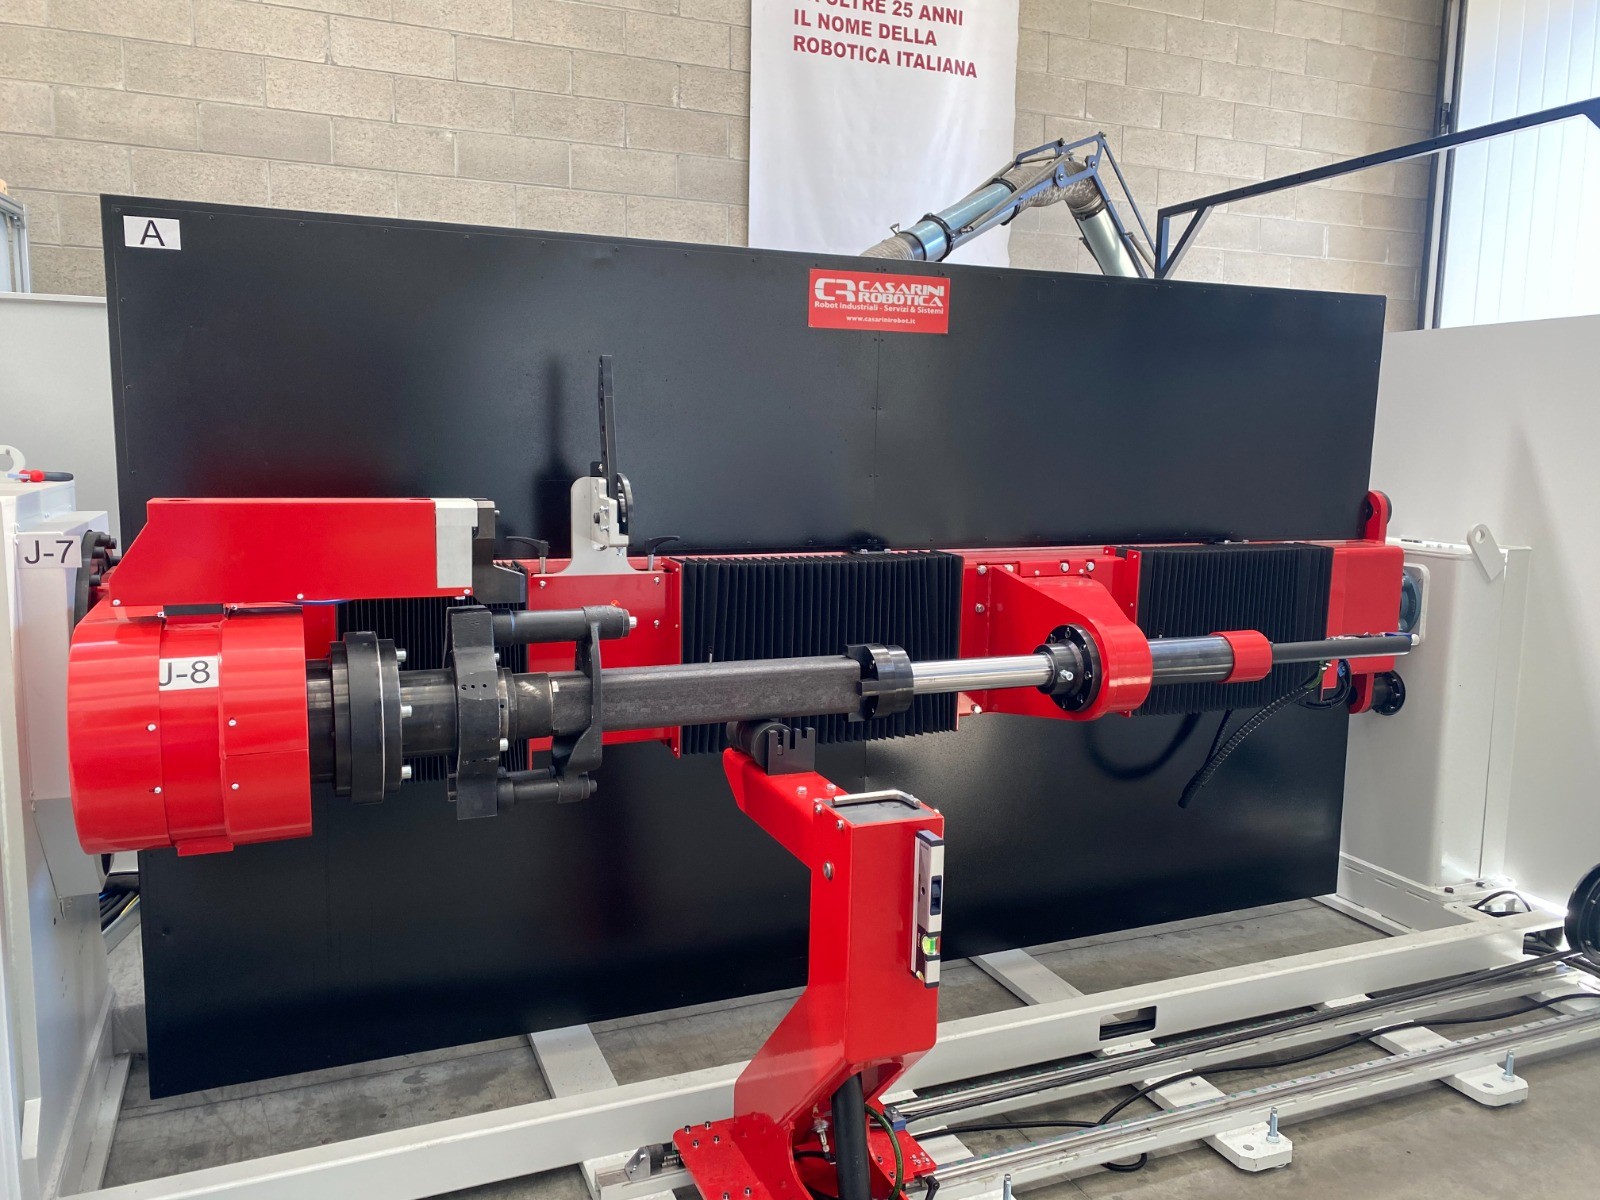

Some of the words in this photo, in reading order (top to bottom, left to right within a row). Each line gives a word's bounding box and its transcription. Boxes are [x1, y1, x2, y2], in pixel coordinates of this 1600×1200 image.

[892, 0, 913, 18] 25
[918, 5, 964, 26] ANNI
[793, 9, 811, 26] IL
[817, 13, 872, 37] NOME
[878, 23, 937, 46] DELLA
[793, 35, 890, 65] ROBOTICA
[897, 50, 978, 78] ITALIANA
[140, 219, 165, 246] A
[858, 280, 945, 296] CASARINI
[858, 291, 943, 307] ROBOTICA
[814, 301, 838, 309] Robot
[840, 302, 878, 311] Industriali
[884, 305, 909, 313] Servizi
[917, 307, 943, 315] Sistemi
[846, 315, 915, 324] www.casarinirobot.it
[24, 540, 74, 564] J-7
[159, 660, 210, 686] J-8
